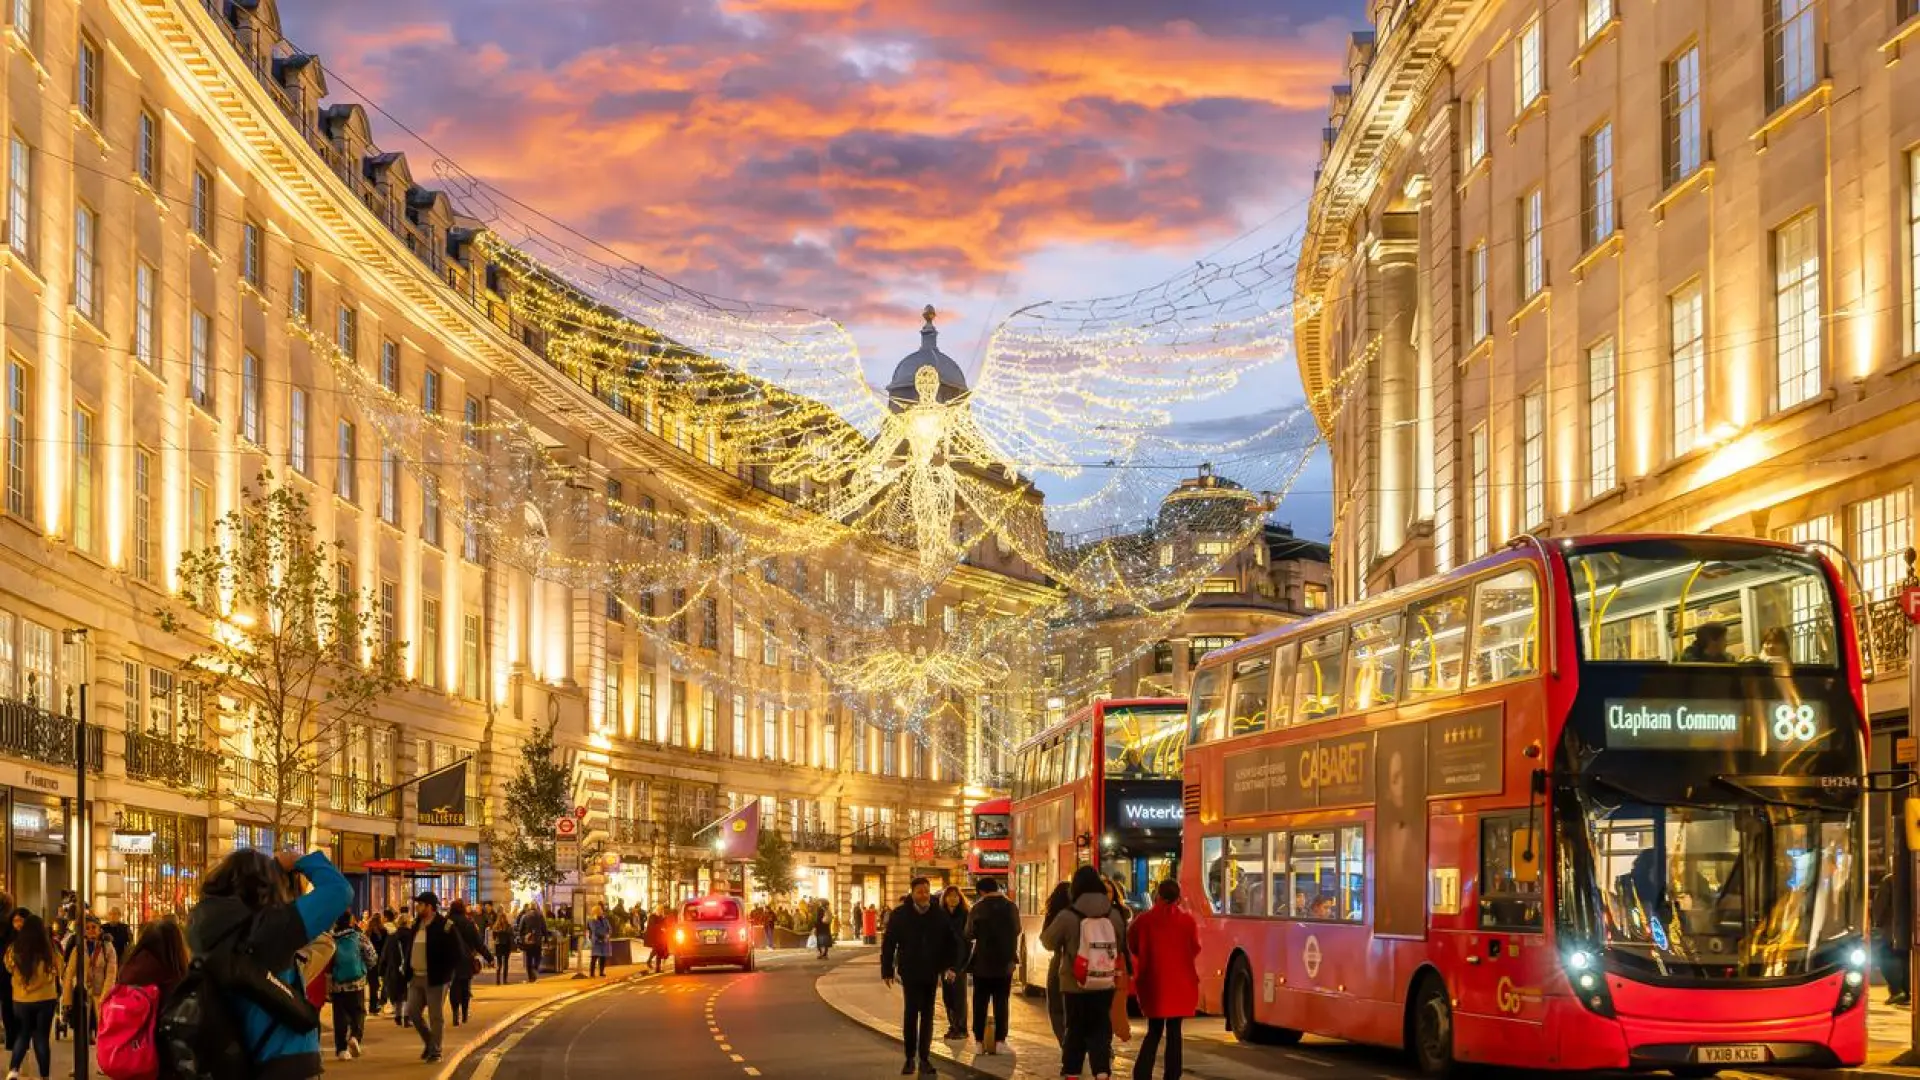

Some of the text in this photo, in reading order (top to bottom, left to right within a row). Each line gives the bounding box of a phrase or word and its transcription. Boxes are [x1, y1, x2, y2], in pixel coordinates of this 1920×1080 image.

[1609, 704, 1816, 741] Clapham Common 88
[1299, 742, 1367, 789] CABARET
[1822, 776, 1858, 787] EH294
[419, 812, 465, 824] HOLLISTER
[1705, 1047, 1759, 1061] YX18 KXG
